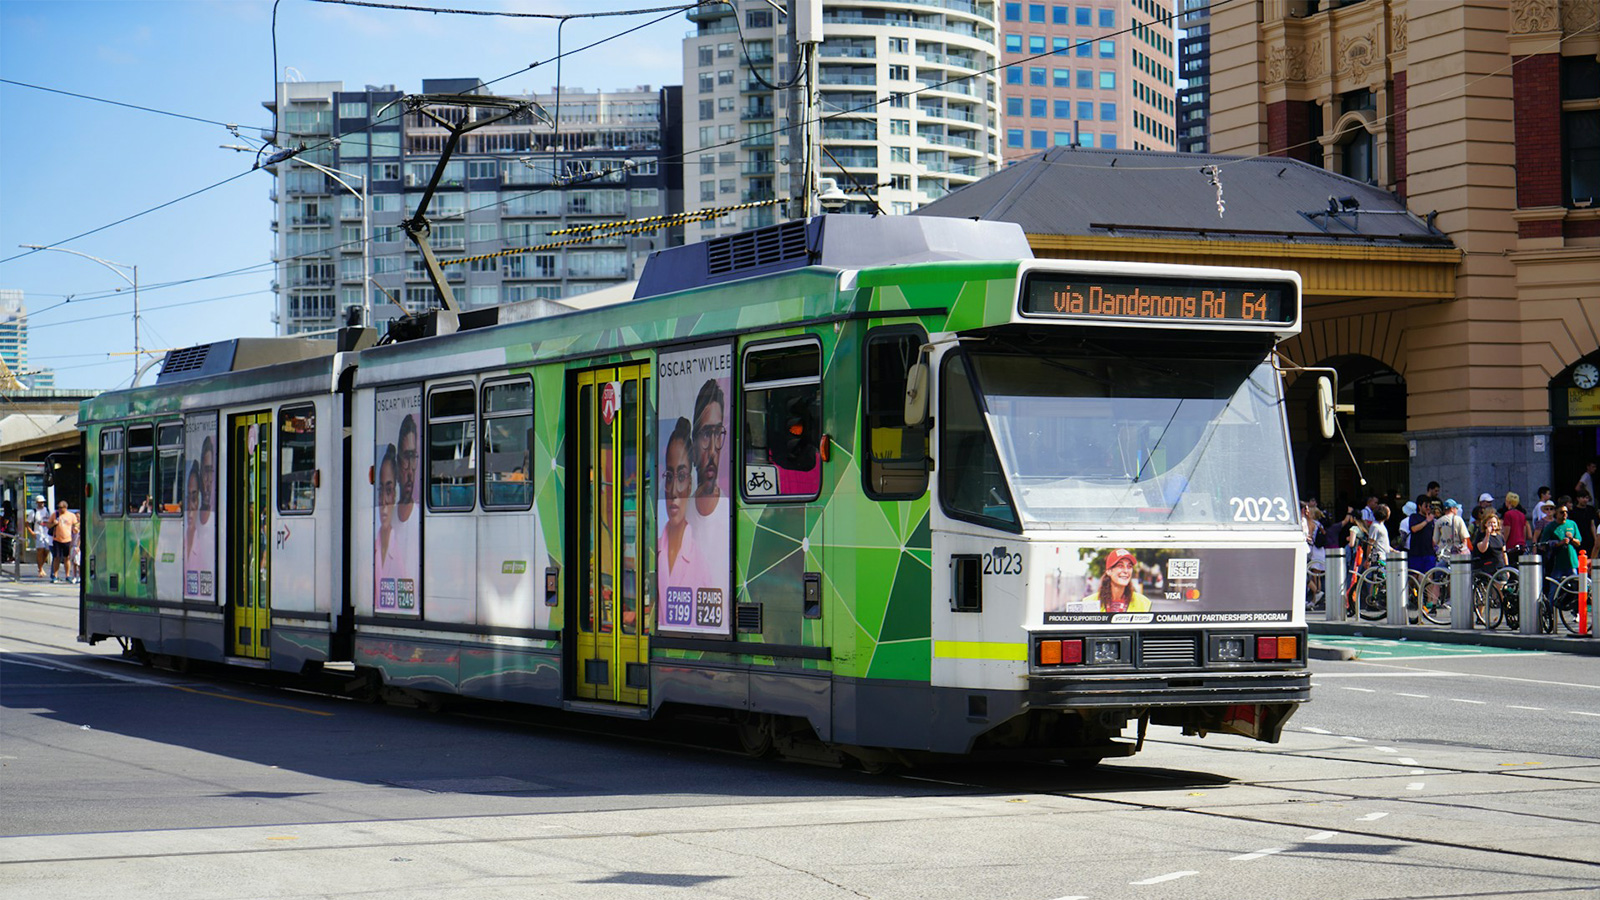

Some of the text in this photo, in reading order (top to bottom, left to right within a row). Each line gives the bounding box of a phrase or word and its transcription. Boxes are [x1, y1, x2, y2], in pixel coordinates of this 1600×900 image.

[1054, 285, 1268, 320] via Dandenong Rd 64
[660, 354, 731, 377] OSCAR WYLEE
[604, 389, 614, 399] STOP
[377, 395, 421, 411] OSCAR WYLEE
[1230, 497, 1290, 522] 2023
[983, 553, 1022, 575] 2023
[1171, 567, 1197, 576] ISSUE
[668, 591, 691, 603] 2 PAIRS
[697, 592, 721, 604] 3 PAIRS
[669, 604, 690, 622] $199
[698, 606, 721, 623] $249
[1254, 613, 1288, 621] PROGRAM
